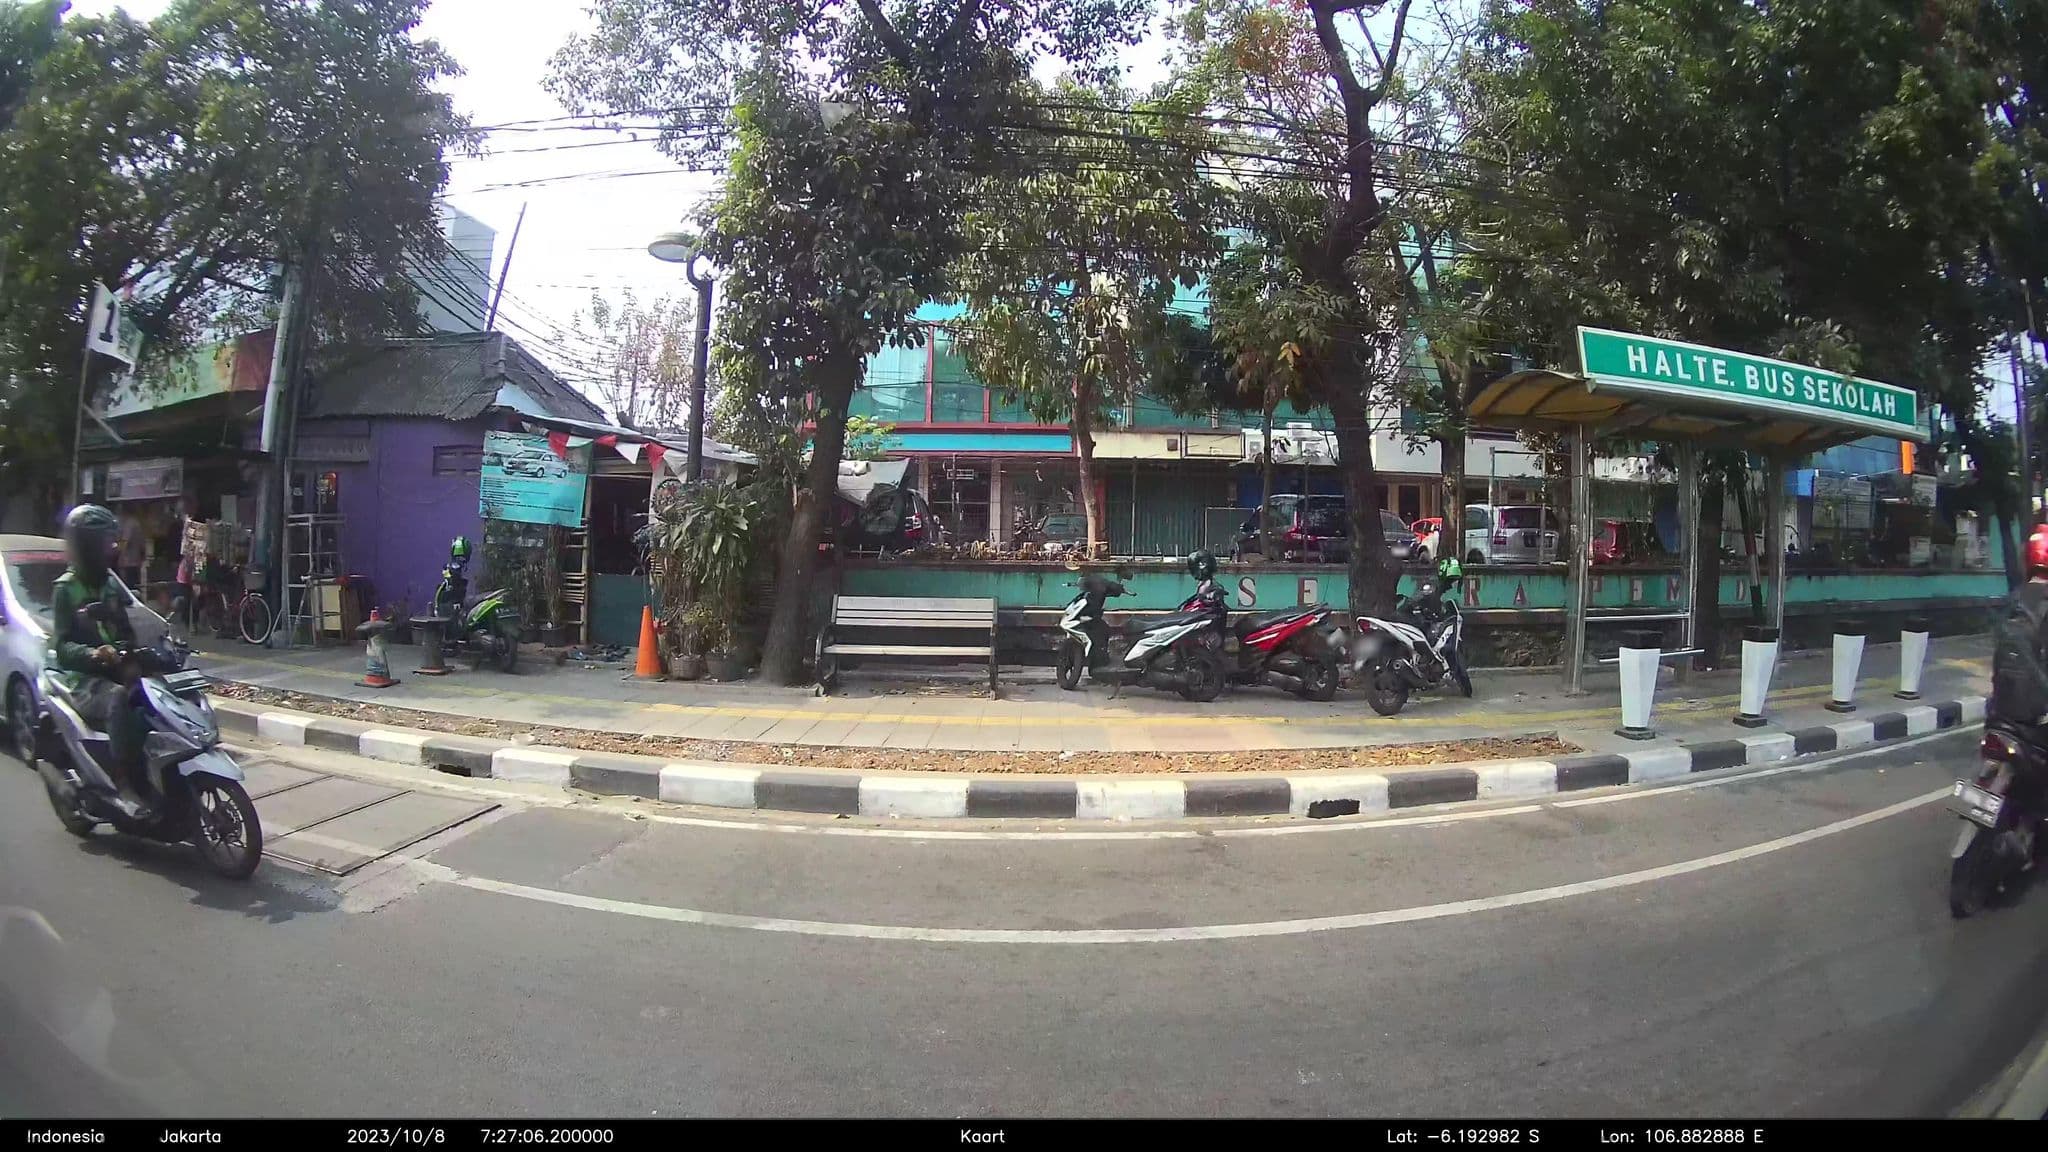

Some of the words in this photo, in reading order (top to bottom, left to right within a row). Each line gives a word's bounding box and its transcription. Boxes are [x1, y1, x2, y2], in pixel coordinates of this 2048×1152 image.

[98, 299, 114, 343] 1
[1626, 344, 1735, 386] HALTE.
[1744, 365, 1796, 397] BUS
[1803, 375, 1896, 417] SEKOLAH
